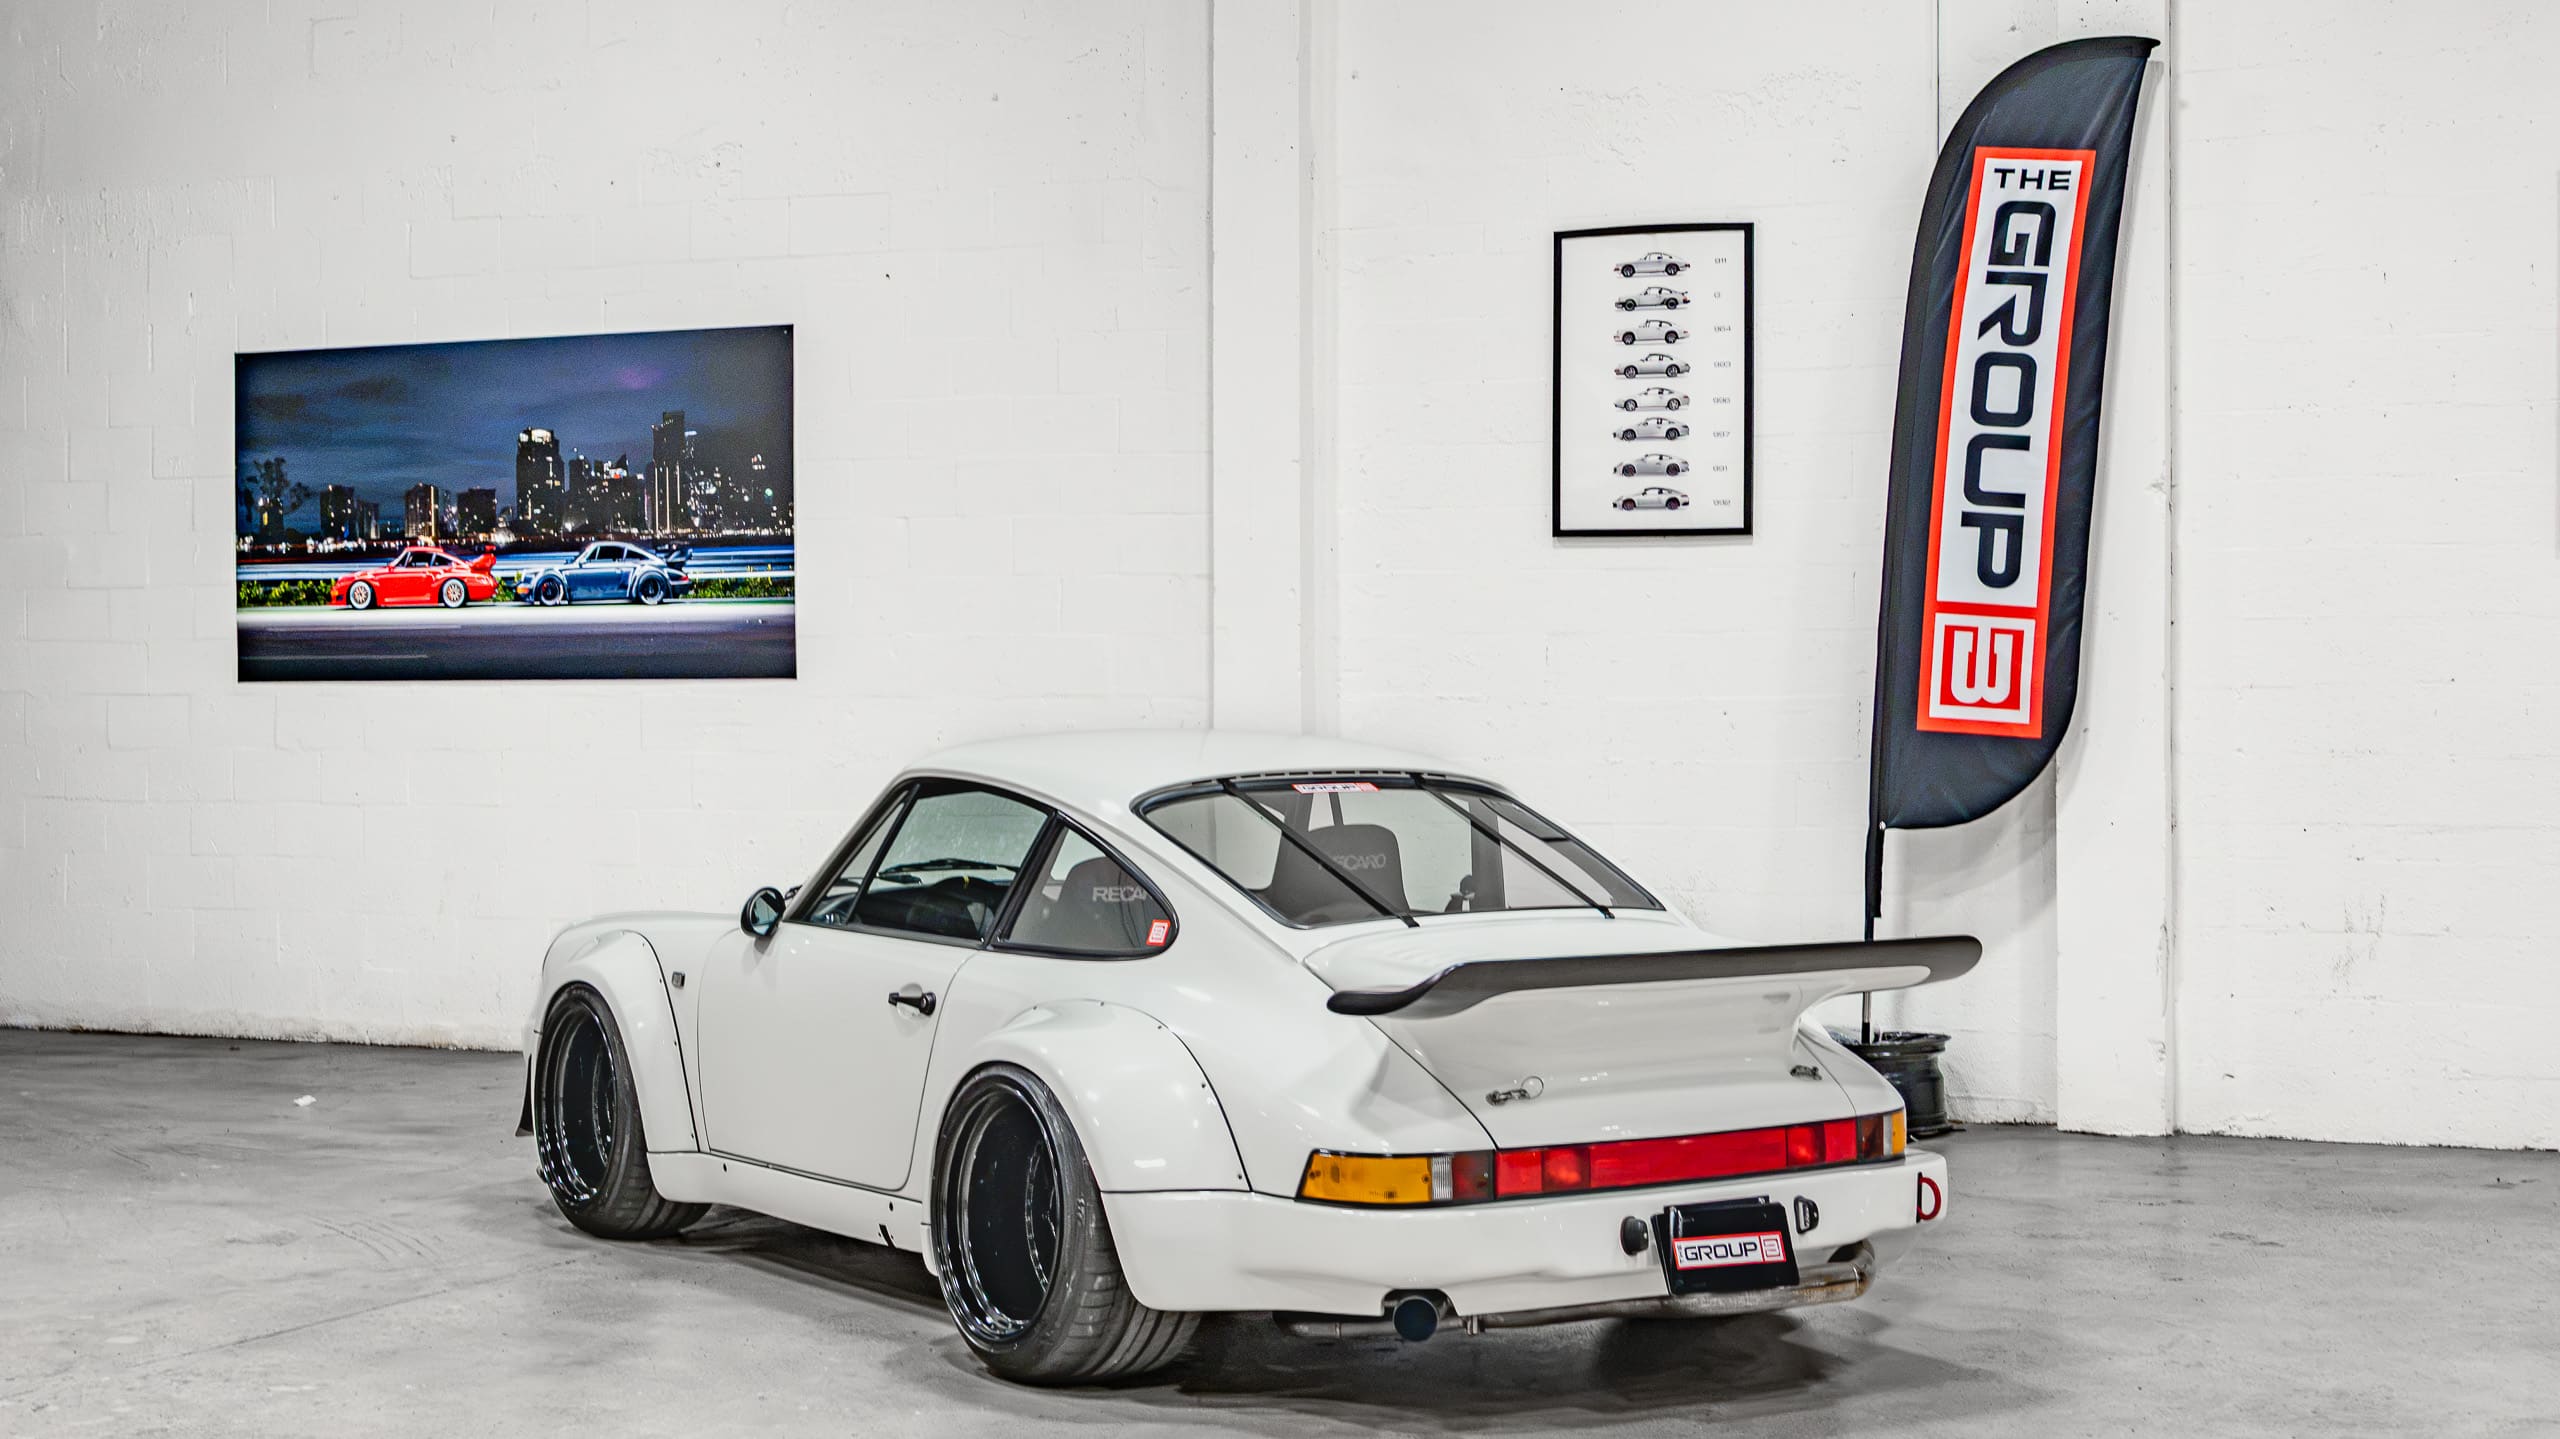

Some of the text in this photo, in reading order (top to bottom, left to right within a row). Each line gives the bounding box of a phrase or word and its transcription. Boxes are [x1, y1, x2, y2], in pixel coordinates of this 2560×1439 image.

[1993, 167, 2072, 191] THE
[1960, 200, 2057, 590] GROUP
[1684, 1241, 1757, 1261] GROUP
